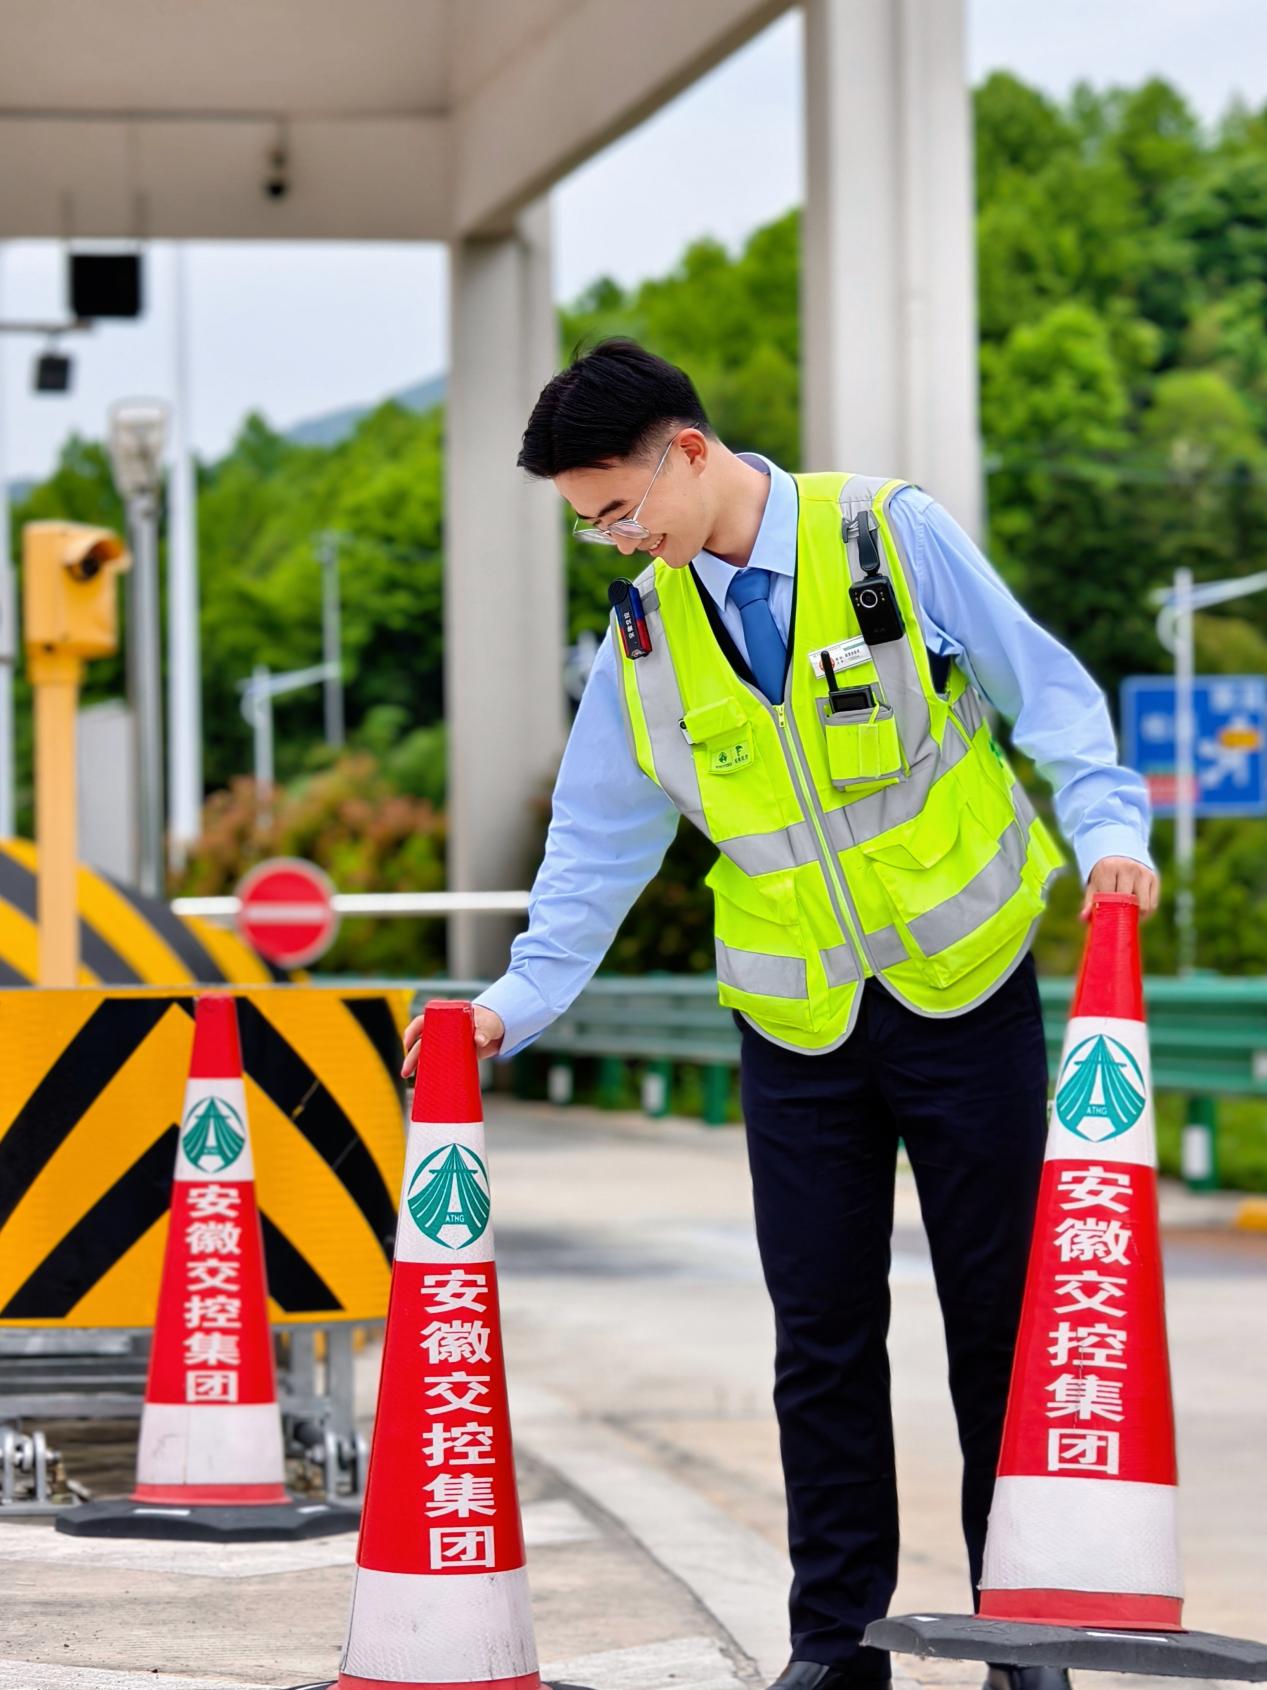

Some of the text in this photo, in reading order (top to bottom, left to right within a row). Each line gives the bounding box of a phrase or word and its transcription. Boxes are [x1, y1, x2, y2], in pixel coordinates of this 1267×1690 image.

[445, 1214, 465, 1223] ATHG
[1086, 1106, 1107, 1115] ATHG
[183, 1184, 242, 1403] 安徽交控集团
[1045, 1166, 1133, 1475] 安徽交控集团
[420, 1269, 497, 1570] 安徽交控集团
